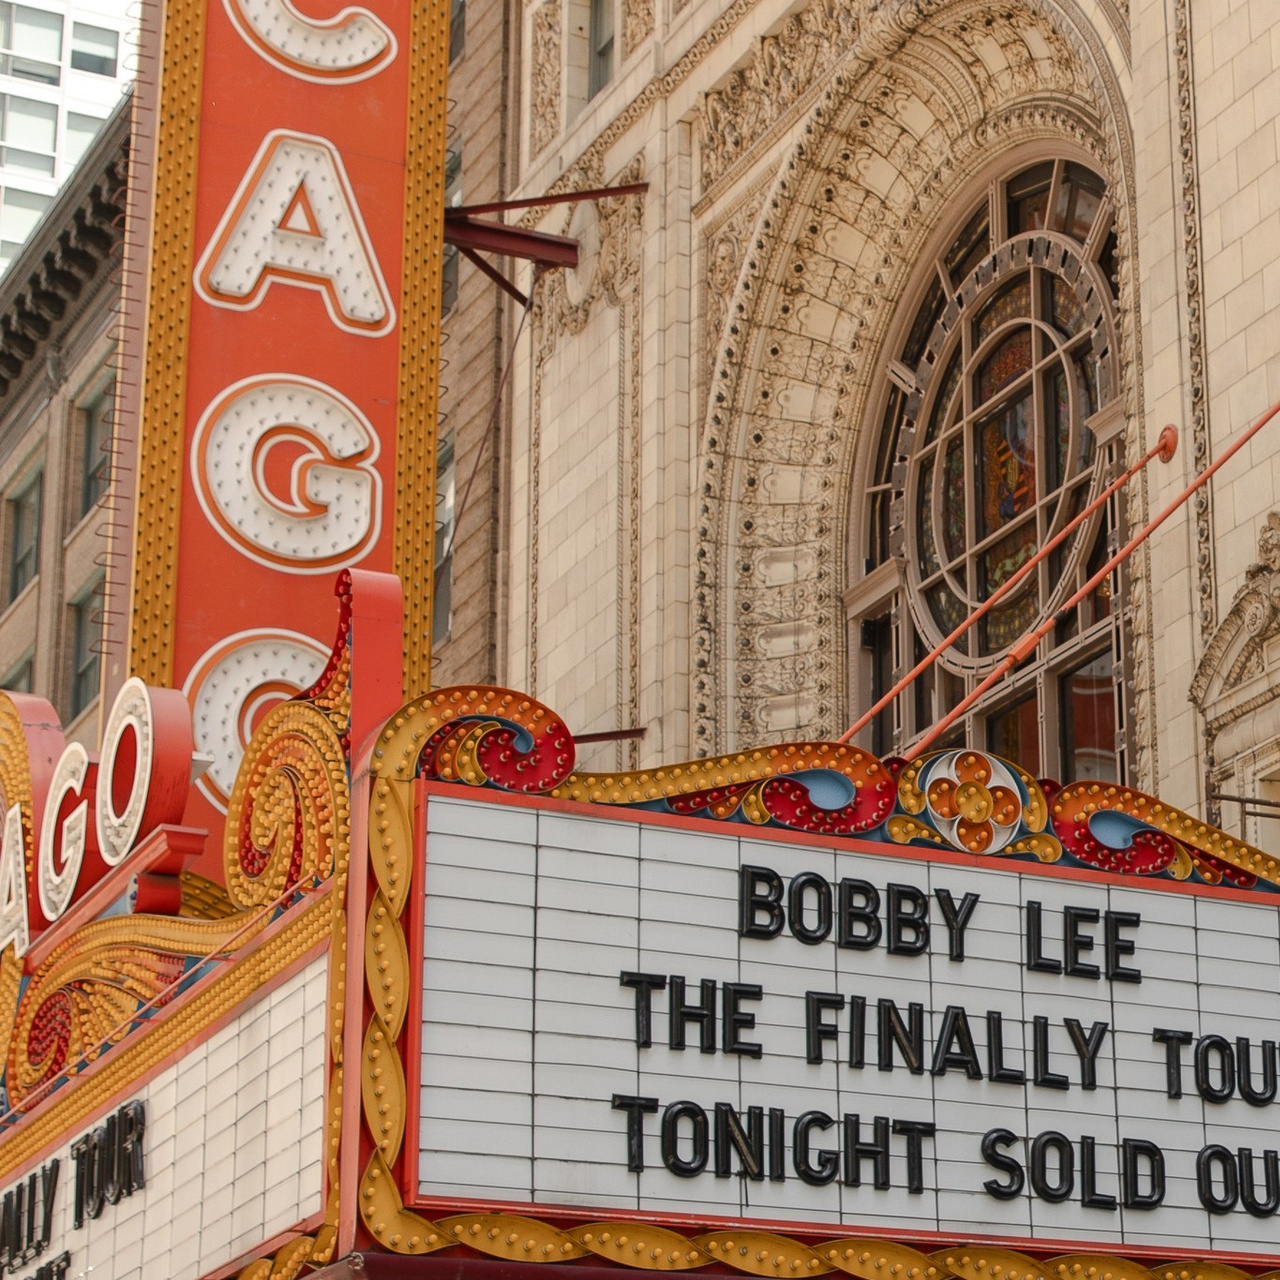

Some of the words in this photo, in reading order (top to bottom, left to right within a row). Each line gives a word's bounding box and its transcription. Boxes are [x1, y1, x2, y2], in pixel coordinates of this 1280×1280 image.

[740, 864, 980, 962] BOBBY
[1027, 900, 1142, 984] LEE
[620, 970, 763, 1059] THE
[805, 990, 1109, 1090] FINALLY
[71, 1099, 145, 1230] TOUR
[611, 1093, 936, 1194] TONIGHT
[981, 1128, 1166, 1211] SOLD
